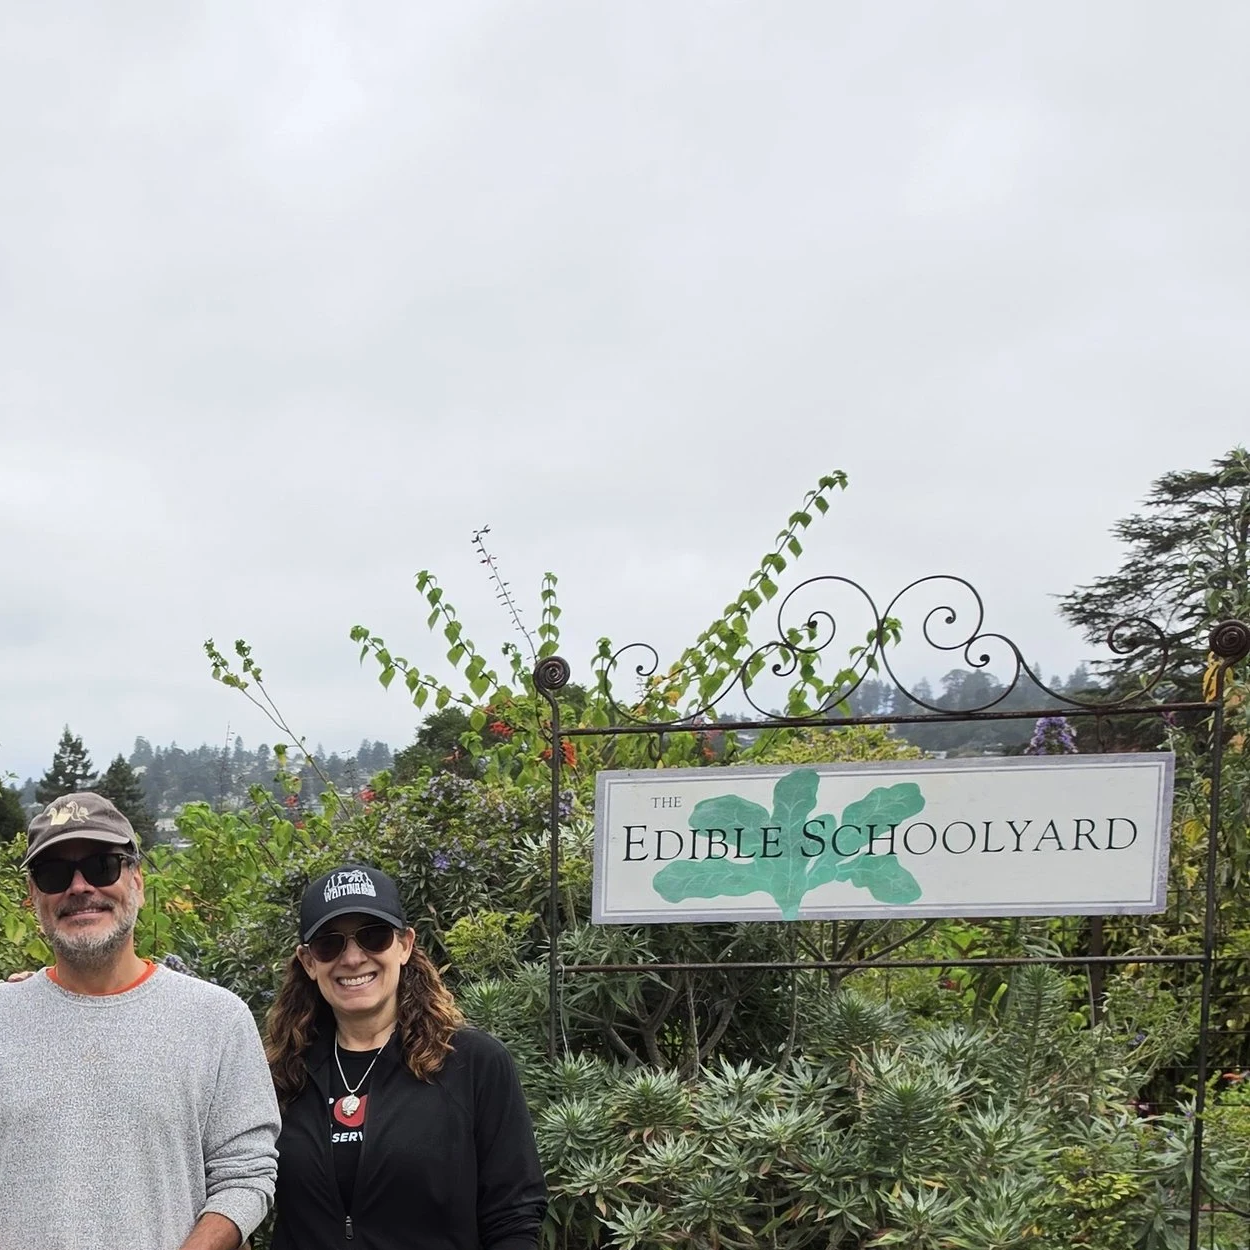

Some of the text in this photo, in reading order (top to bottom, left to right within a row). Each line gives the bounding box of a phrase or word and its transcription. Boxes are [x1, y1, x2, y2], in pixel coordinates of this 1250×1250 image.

[651, 796, 682, 809] THE
[622, 817, 1139, 862] EDIBLE SCHOOLYARD
